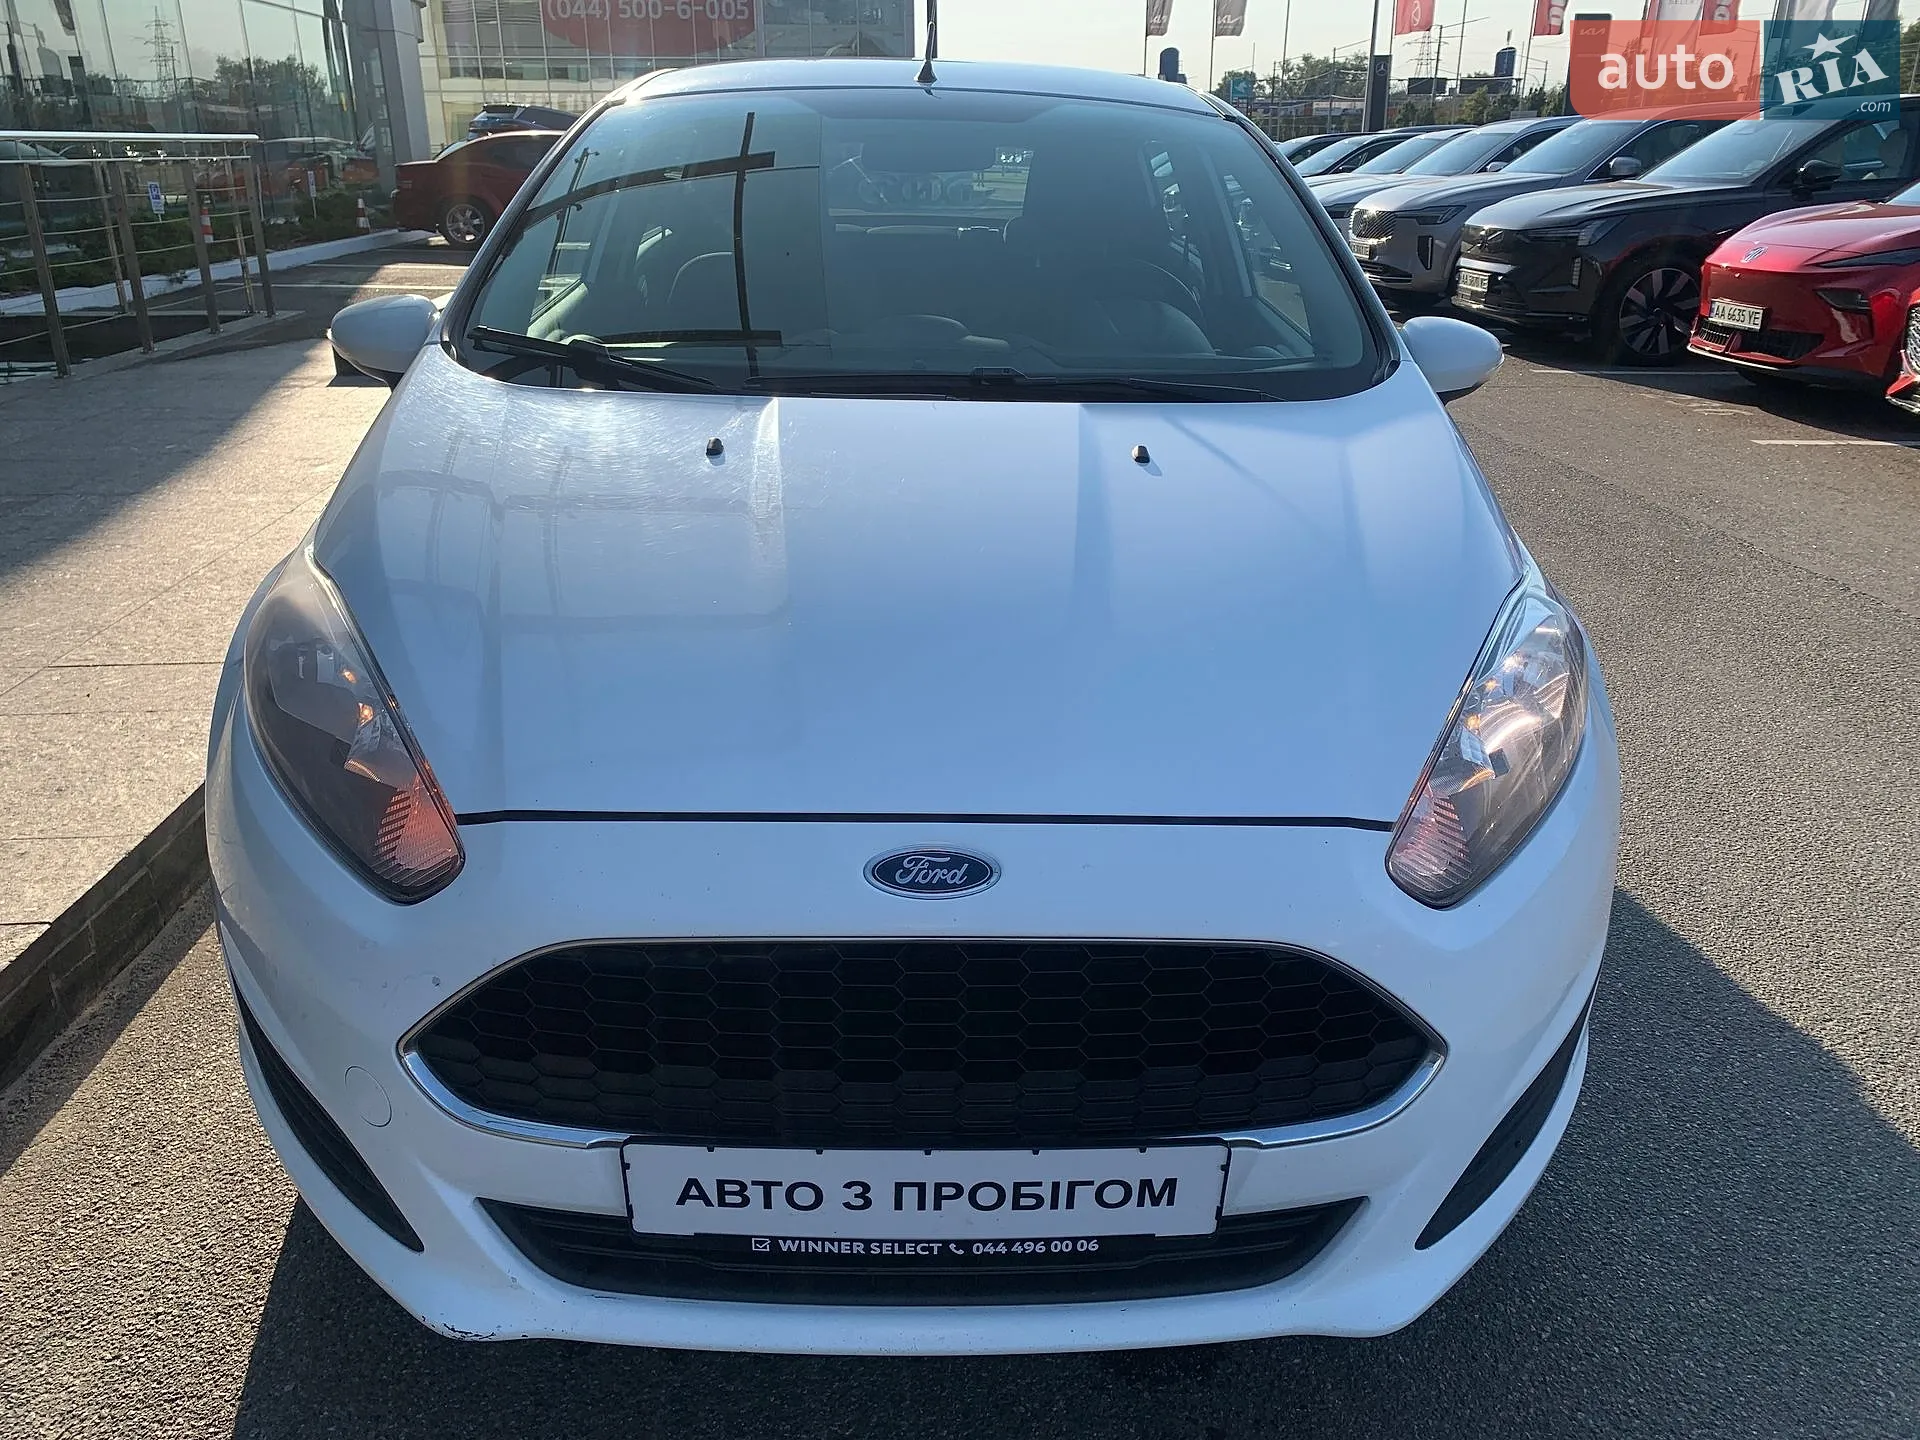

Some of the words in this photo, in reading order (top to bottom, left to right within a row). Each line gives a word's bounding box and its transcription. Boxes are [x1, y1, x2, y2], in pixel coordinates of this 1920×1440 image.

[547, 0, 609, 20] (044)
[618, 0, 749, 20] 500-6-005
[1715, 305, 1726, 320] AA
[1727, 307, 1746, 323] 6635
[1748, 310, 1761, 326] YE
[895, 855, 969, 885] Ford
[675, 1177, 824, 1212] АВТО
[893, 1177, 1178, 1212] ПРОБІГОМ
[778, 1239, 865, 1255] WINNER
[870, 1242, 942, 1255] SELECT
[972, 1242, 1008, 1255] 044
[1011, 1241, 1046, 1254] 496
[1050, 1240, 1073, 1253] 00
[1076, 1239, 1099, 1252] 06
